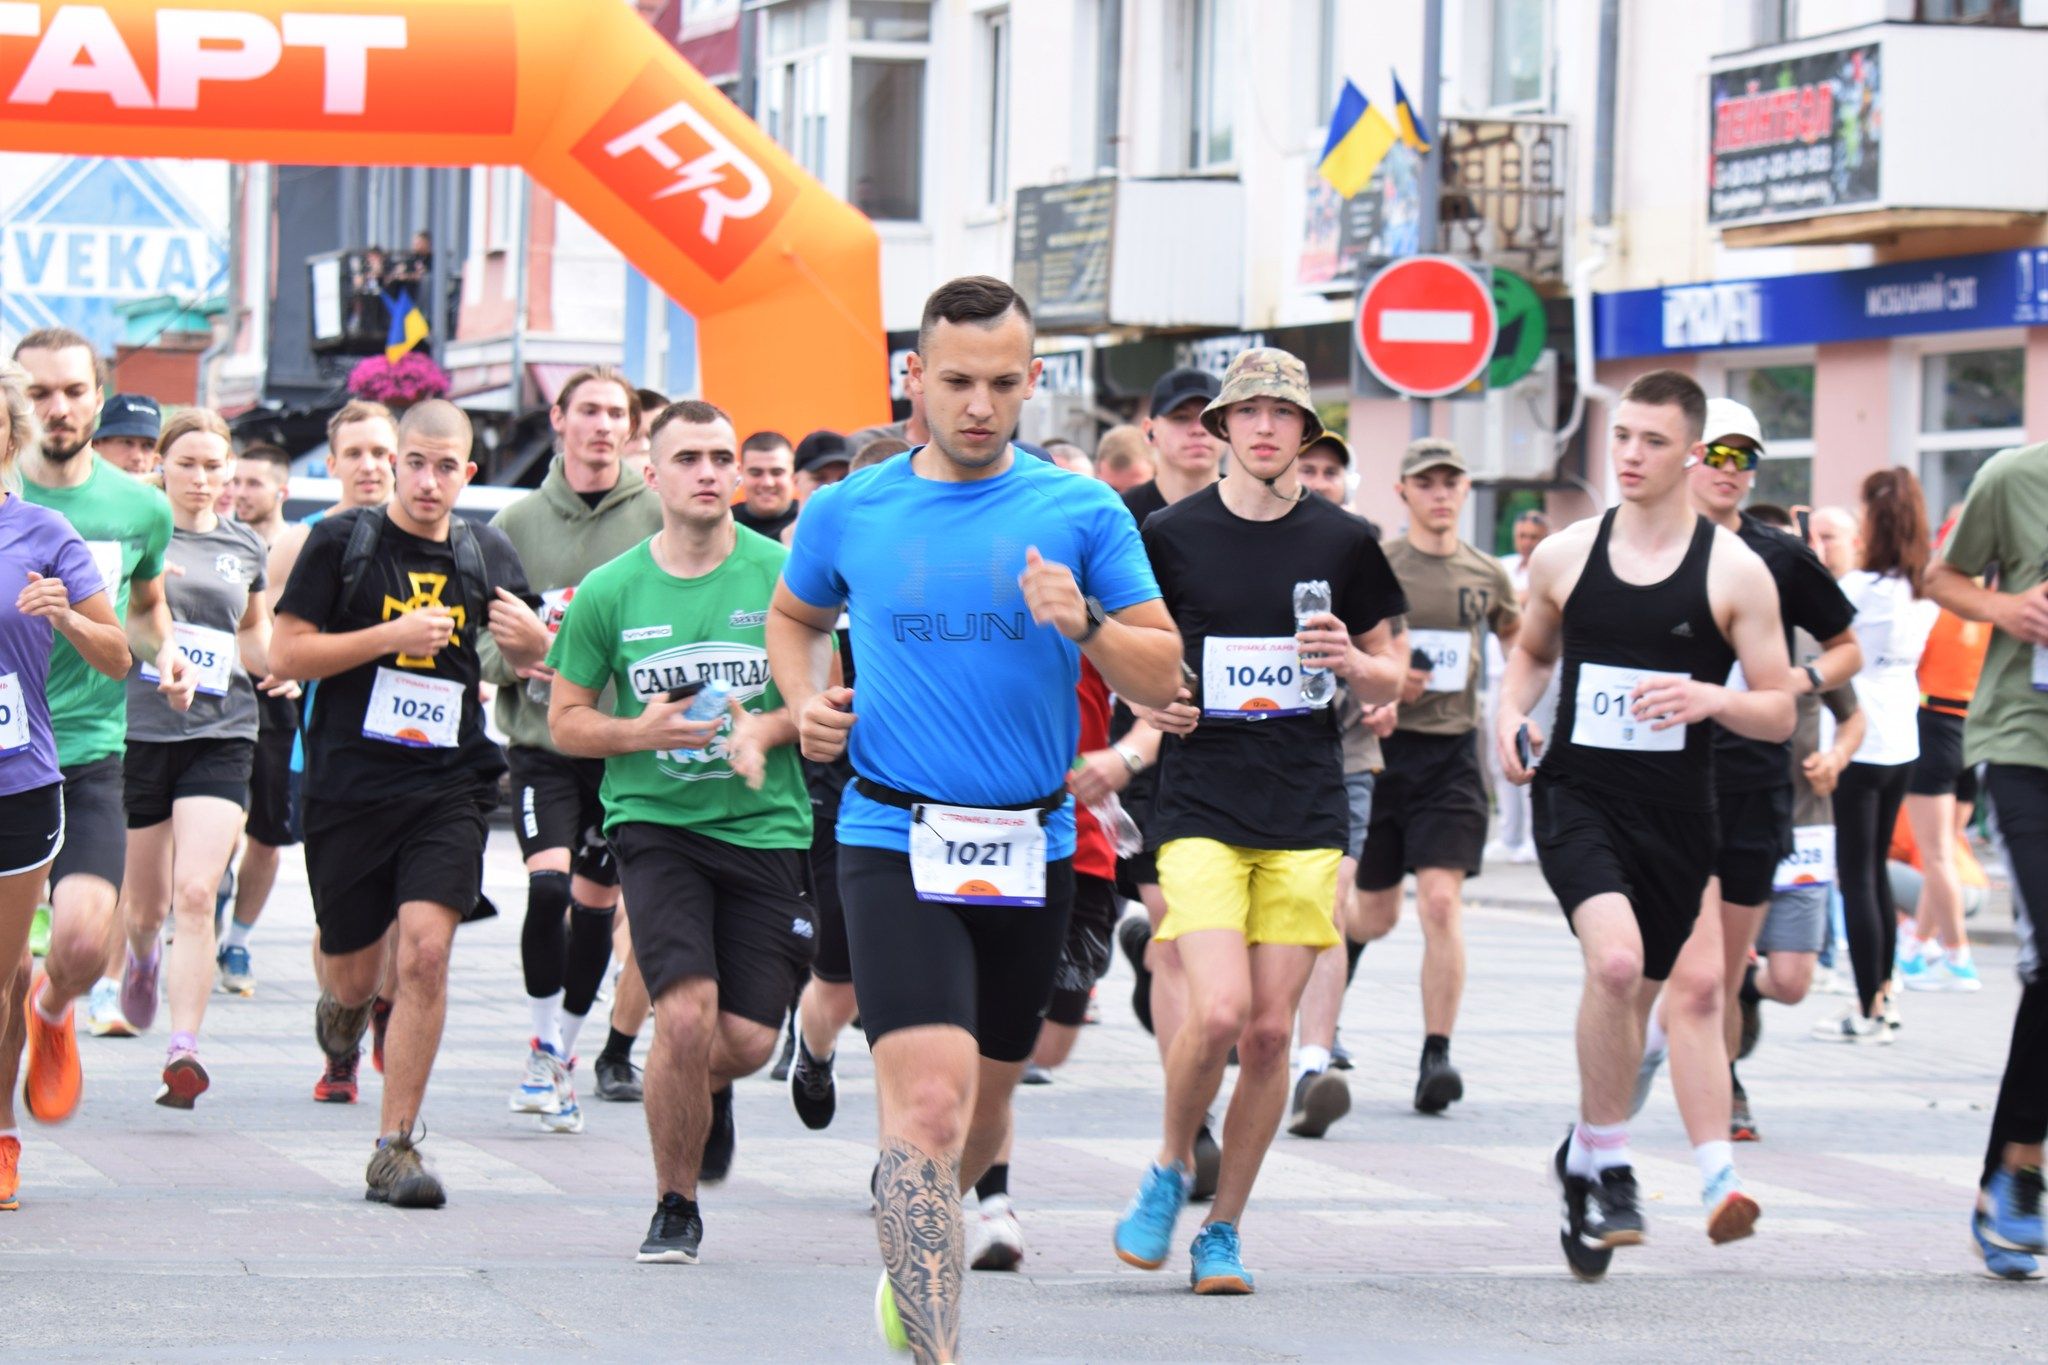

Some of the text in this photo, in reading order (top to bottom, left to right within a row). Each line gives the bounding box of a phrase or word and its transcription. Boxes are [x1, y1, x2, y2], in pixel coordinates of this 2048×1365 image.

[15, 232, 197, 289] VEKA
[892, 612, 1026, 642] RUN
[1226, 666, 1293, 686] 1040
[392, 696, 445, 723] 1026
[945, 840, 1012, 866] 1021
